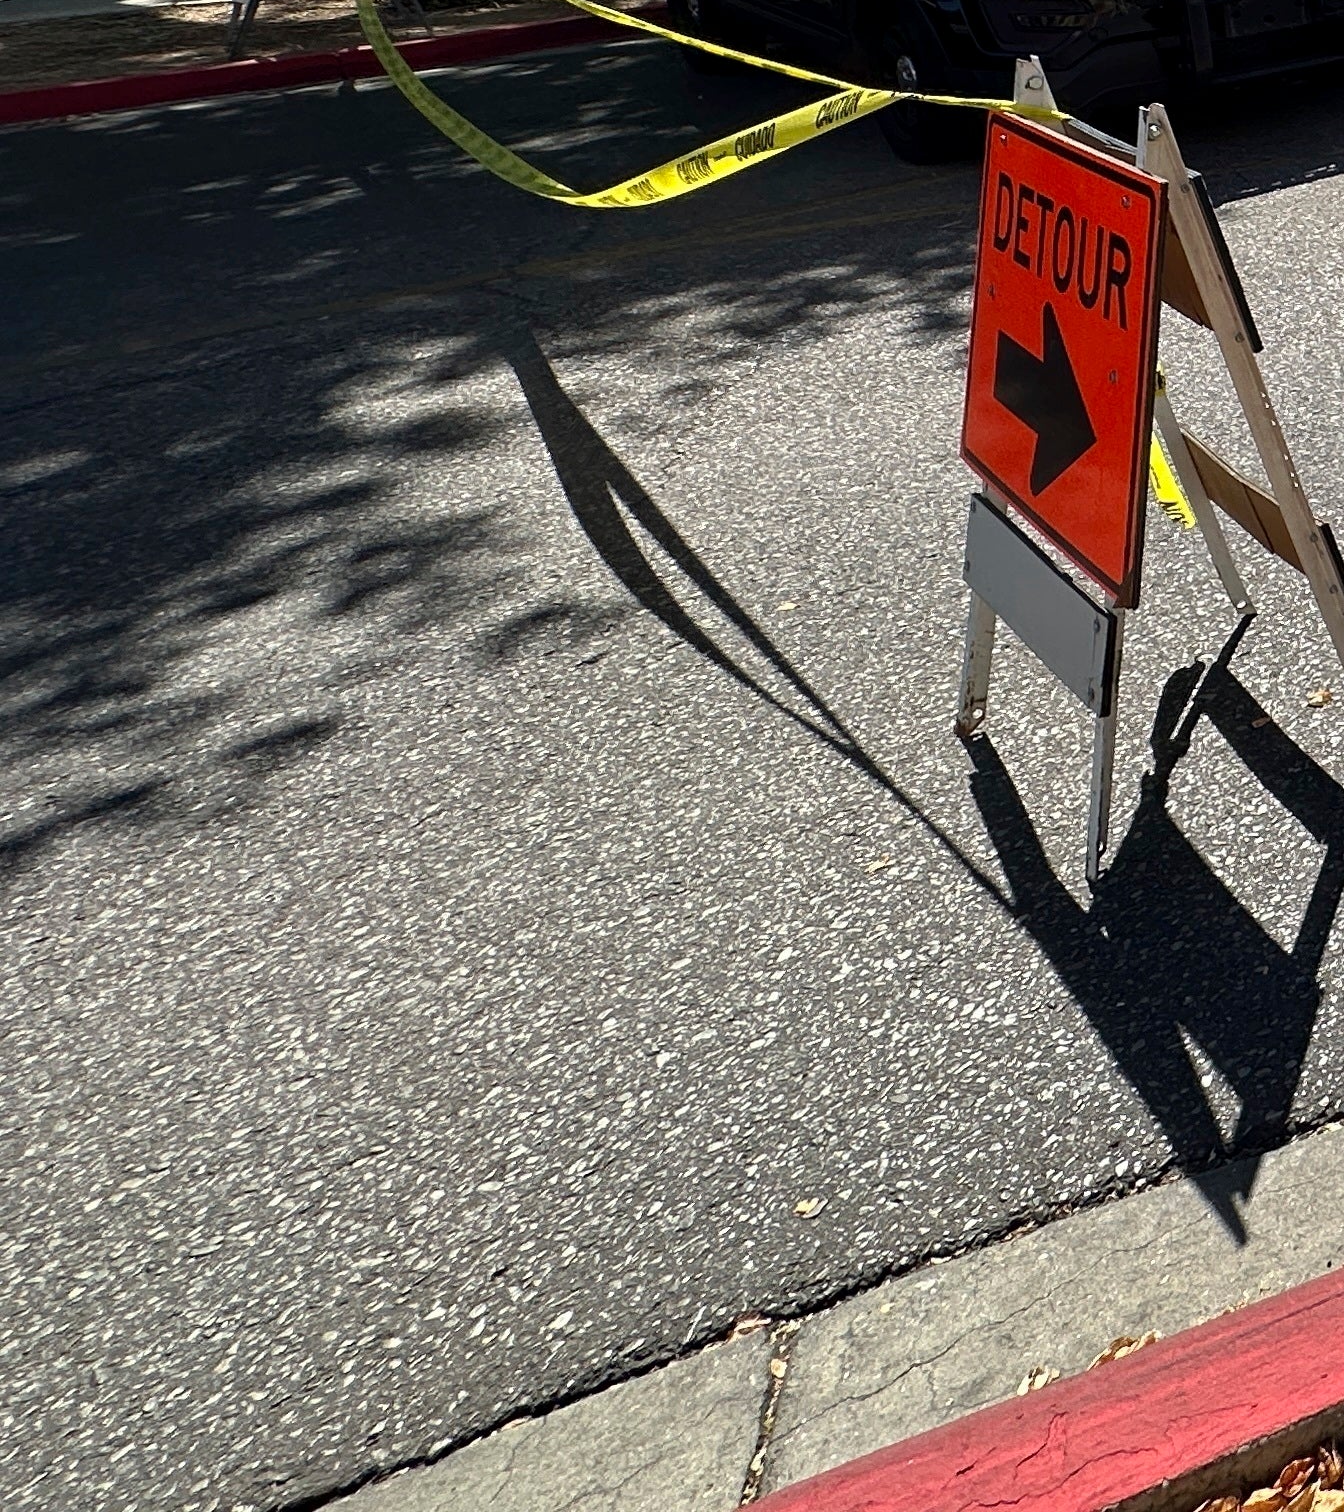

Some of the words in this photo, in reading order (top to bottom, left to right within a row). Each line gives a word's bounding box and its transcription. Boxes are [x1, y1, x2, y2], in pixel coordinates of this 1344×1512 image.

[816, 90, 865, 129] CAUTION
[735, 122, 776, 162] CUIDADO
[993, 171, 1132, 332] DETOUR
